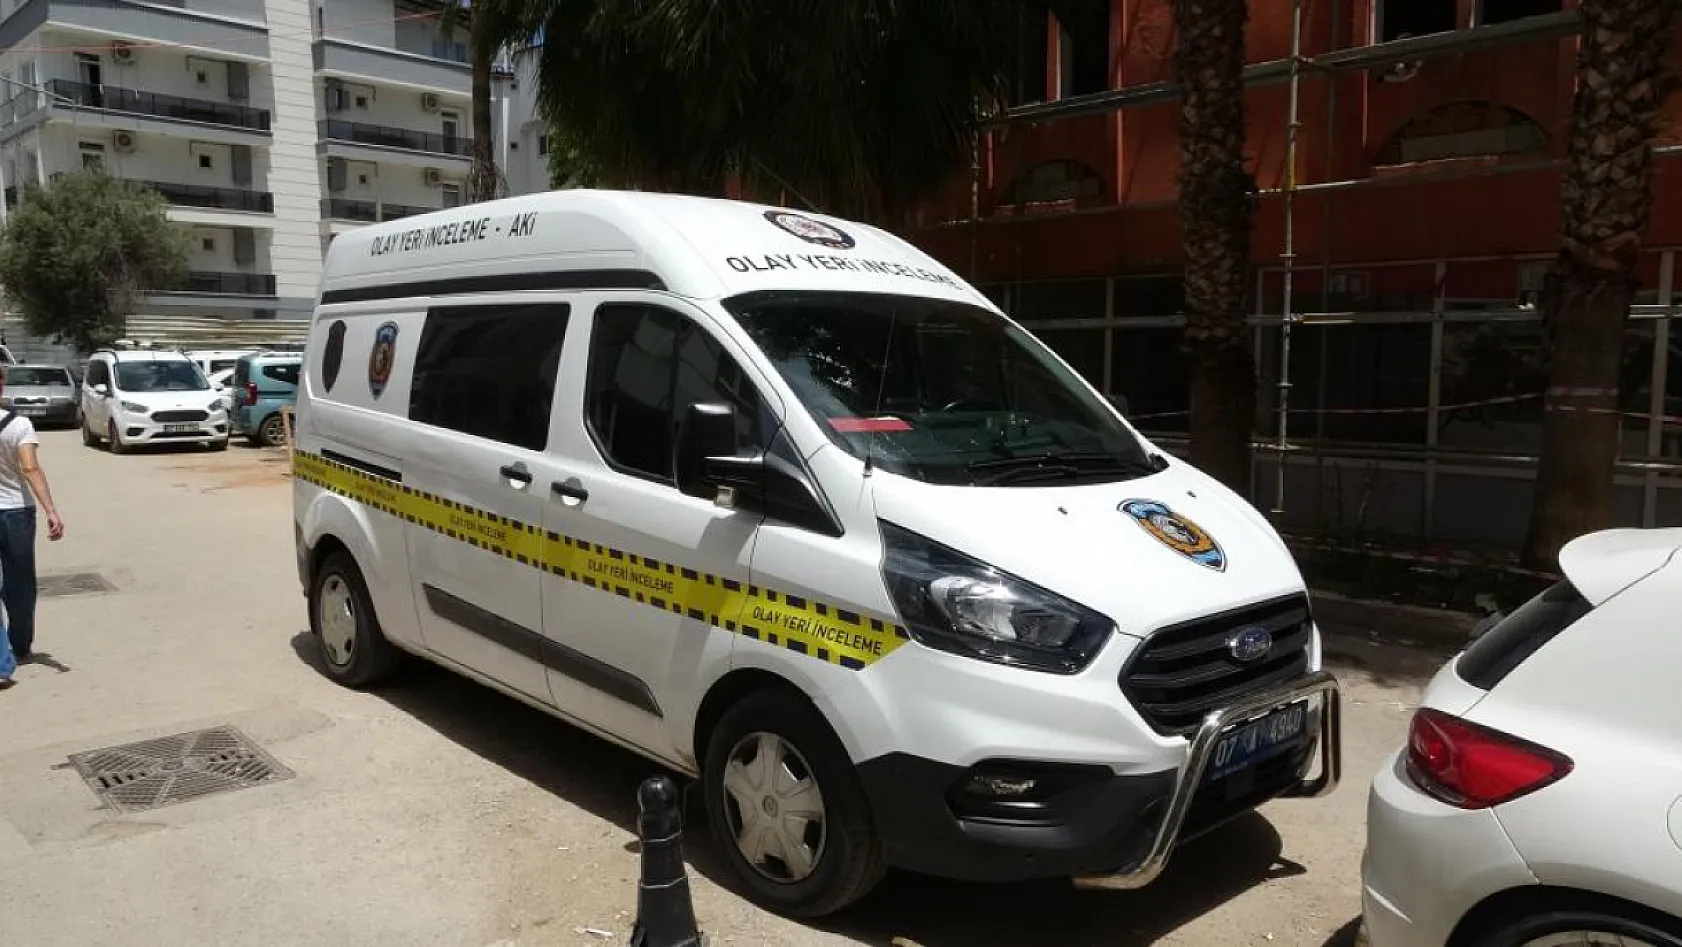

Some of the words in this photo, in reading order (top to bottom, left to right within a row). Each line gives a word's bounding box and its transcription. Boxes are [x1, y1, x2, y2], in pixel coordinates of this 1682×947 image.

[371, 235, 398, 257] OLAY
[726, 254, 797, 272] OLAY
[753, 606, 782, 625] OLAY
[783, 613, 812, 634] YERİ
[811, 620, 882, 656] İNCELEME
[1214, 735, 1239, 767] 07
